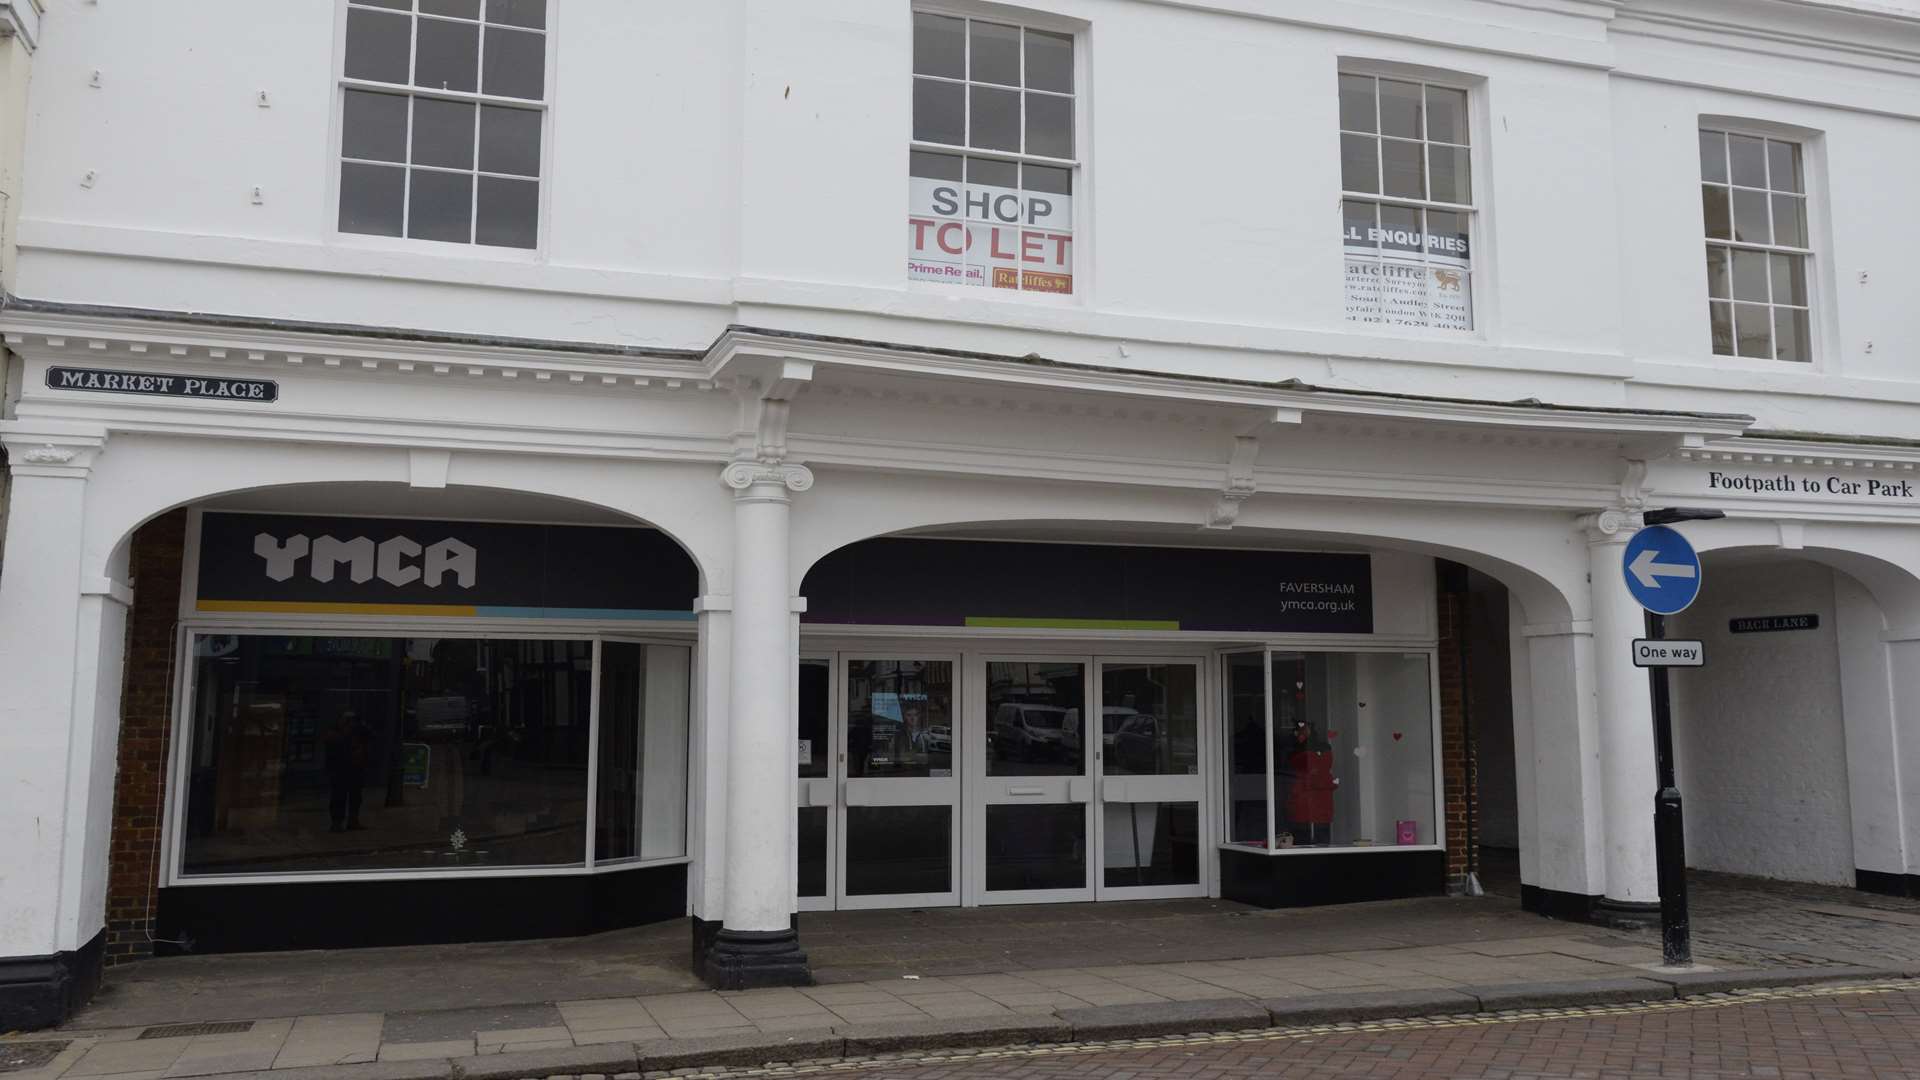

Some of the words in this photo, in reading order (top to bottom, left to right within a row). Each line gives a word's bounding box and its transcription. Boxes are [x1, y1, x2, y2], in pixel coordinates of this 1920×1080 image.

[932, 187, 1052, 224] SHOP
[909, 218, 972, 255] TO
[990, 227, 1073, 265] LET
[908, 262, 943, 275] Prime
[944, 265, 983, 279] Reail.
[1345, 264, 1426, 280] atcliffe
[999, 273, 1053, 288] Racliffes
[60, 371, 175, 393] MARKET
[183, 379, 265, 399] PLACE
[1708, 471, 1796, 493] Footpath
[1802, 477, 1821, 493] to
[1826, 476, 1861, 495] Car
[1867, 479, 1913, 497] Park
[254, 532, 477, 589] YMCA
[1280, 582, 1354, 594] FAVERSHAM
[1281, 600, 1355, 613] ymca.org.uk
[1640, 646, 1667, 658] One
[1671, 648, 1697, 660] way
